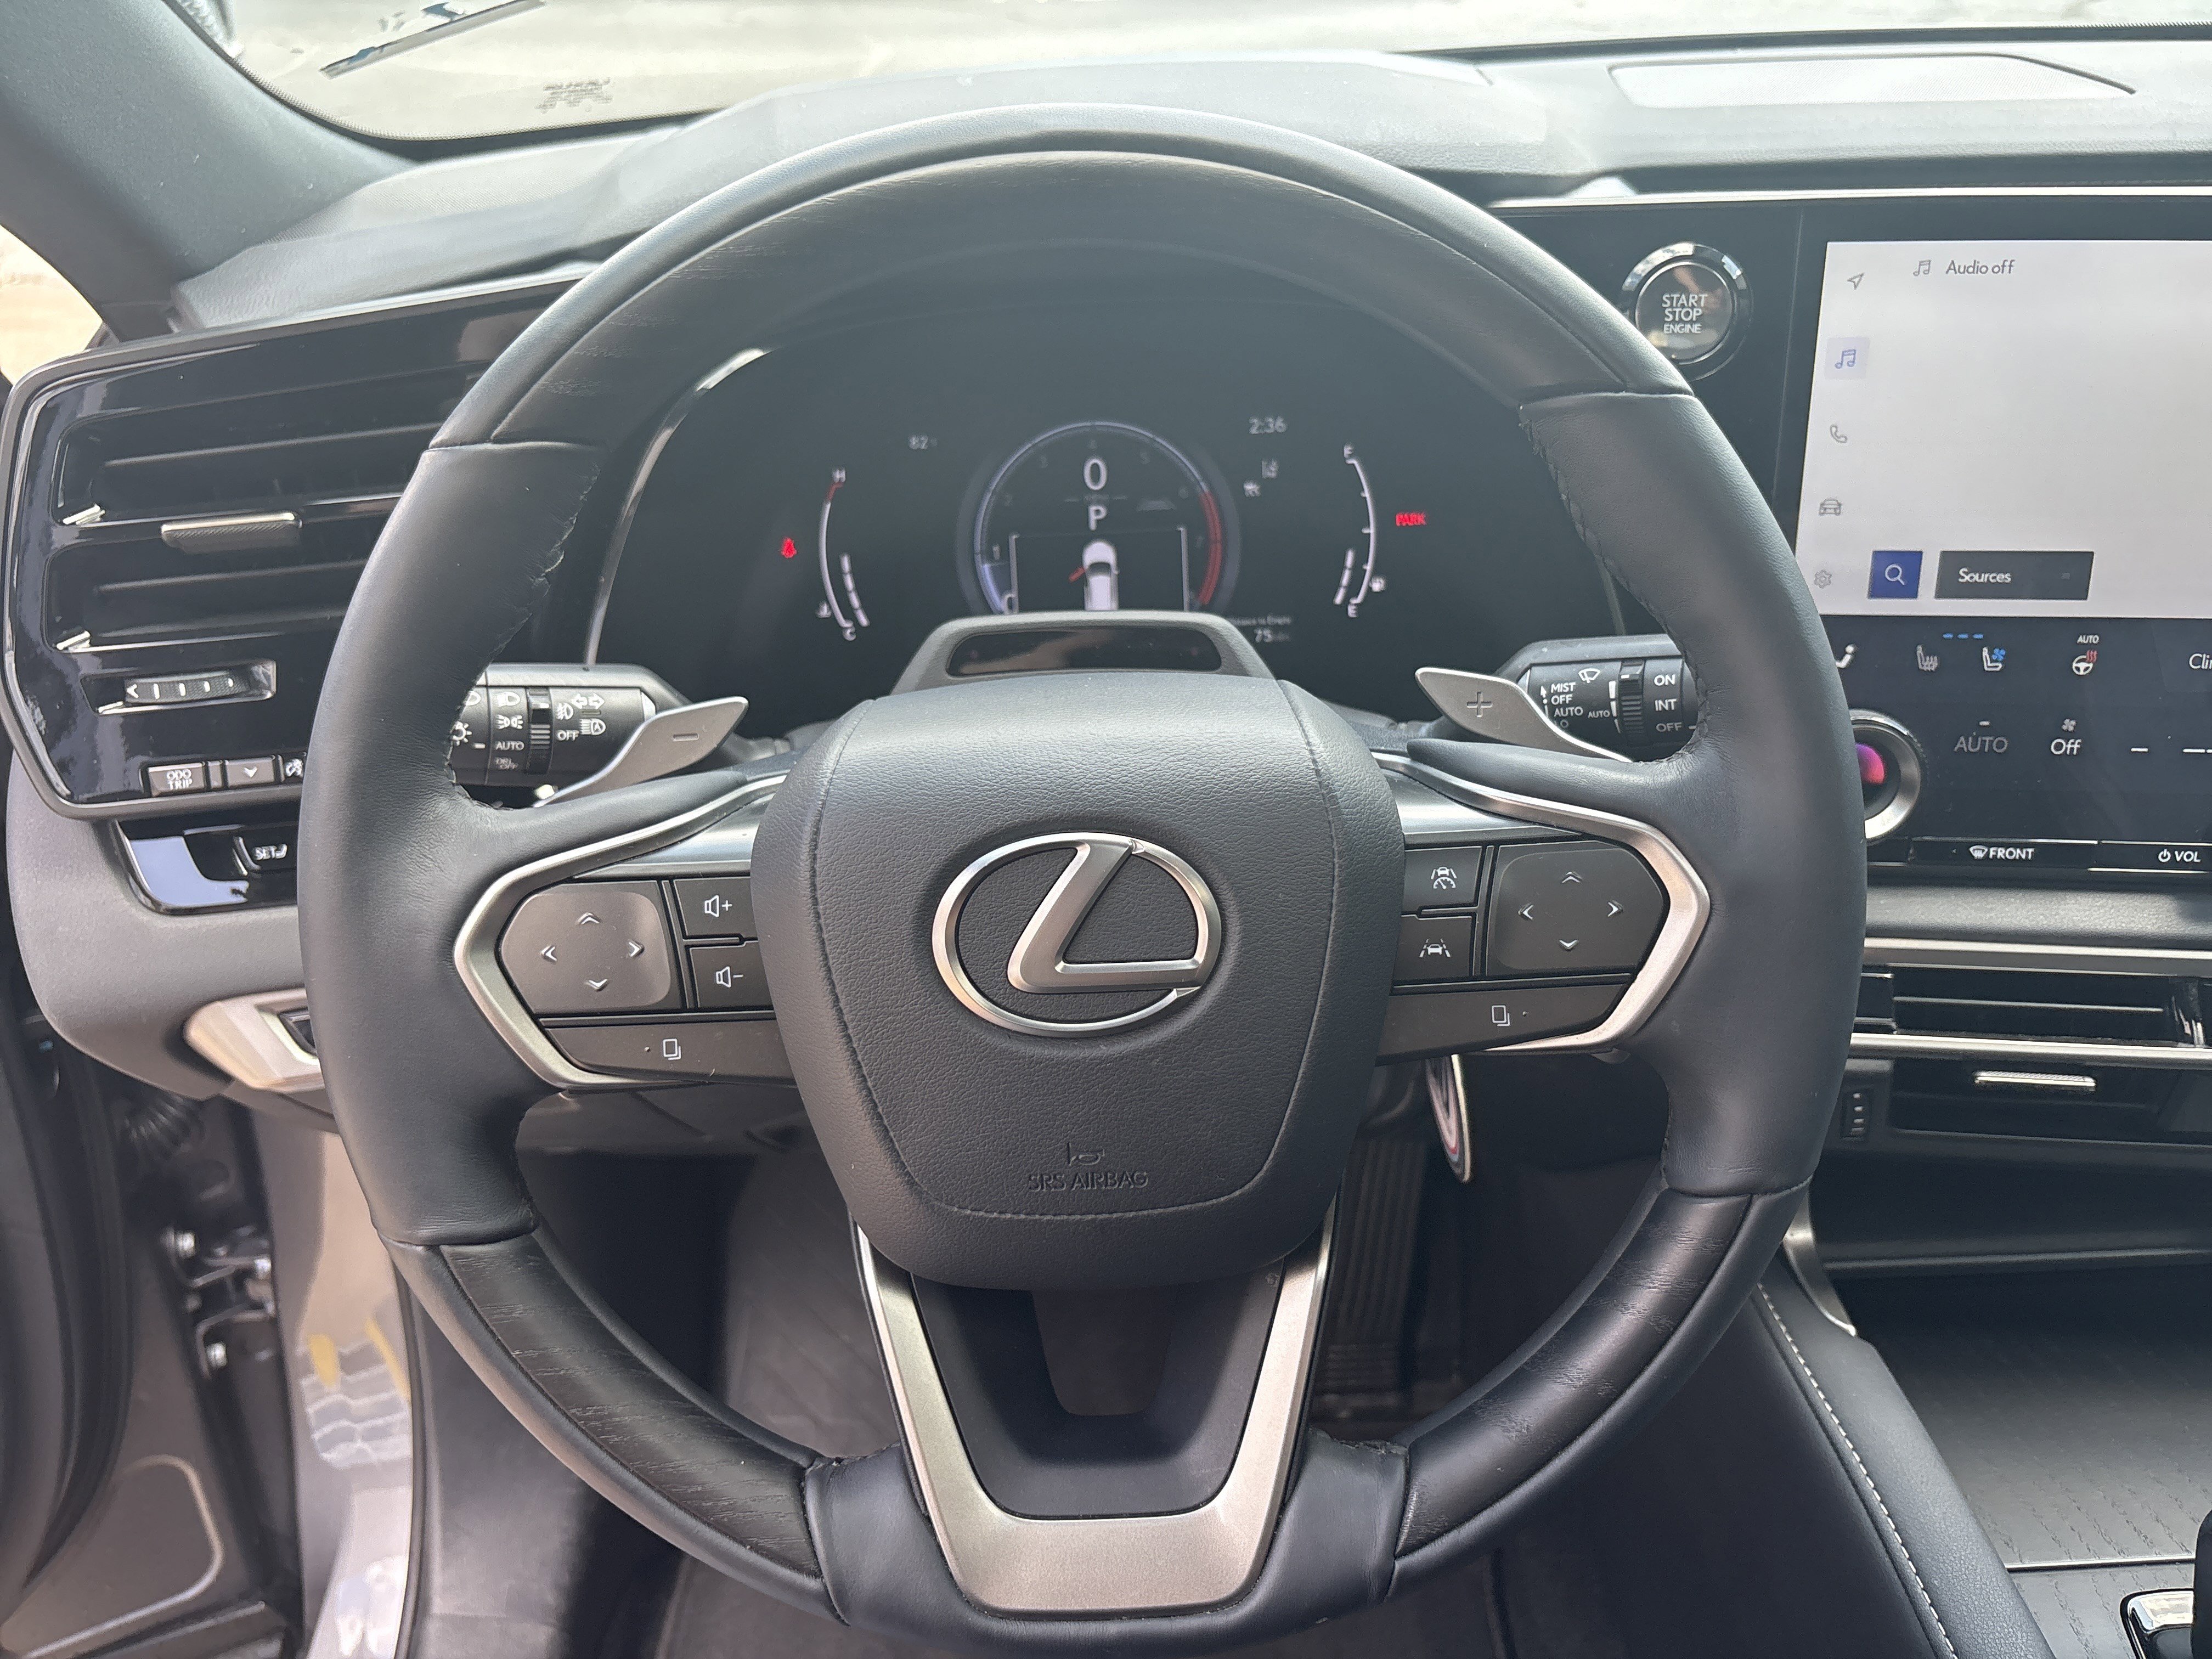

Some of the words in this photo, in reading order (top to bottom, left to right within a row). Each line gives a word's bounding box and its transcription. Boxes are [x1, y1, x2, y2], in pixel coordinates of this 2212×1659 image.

[1945, 259, 1989, 274] Audio
[1991, 259, 2016, 274] off
[1662, 293, 1708, 308] START
[1664, 308, 1702, 322] STOP
[1663, 324, 1702, 334] ENGINE
[1248, 417, 1287, 435] 2:36
[832, 468, 847, 483] H
[1083, 457, 1108, 490] 0
[1088, 505, 1108, 531] P
[1958, 568, 2012, 584] Sources
[1347, 604, 1358, 618] E
[2077, 634, 2100, 644] AUTO
[1654, 674, 1676, 686] ON
[1551, 682, 1576, 693] MIST
[1551, 694, 1573, 705] OFF
[1655, 698, 1677, 712] INT
[1554, 706, 1583, 717] AUTO
[1588, 710, 1610, 719] AUTO
[1656, 721, 1682, 732] OFF
[556, 730, 579, 741] OFF
[495, 741, 524, 751] AUTO
[1954, 736, 2008, 754] AUTO
[2050, 738, 2081, 755] Off
[166, 769, 192, 780] ODO
[167, 778, 193, 790] TRIP
[253, 845, 277, 861] SET
[1989, 847, 2035, 861] FRONT
[2174, 850, 2201, 863] VOL
[1028, 1172, 1067, 1192] SRS
[1071, 1170, 1149, 1191] AIRBAG
